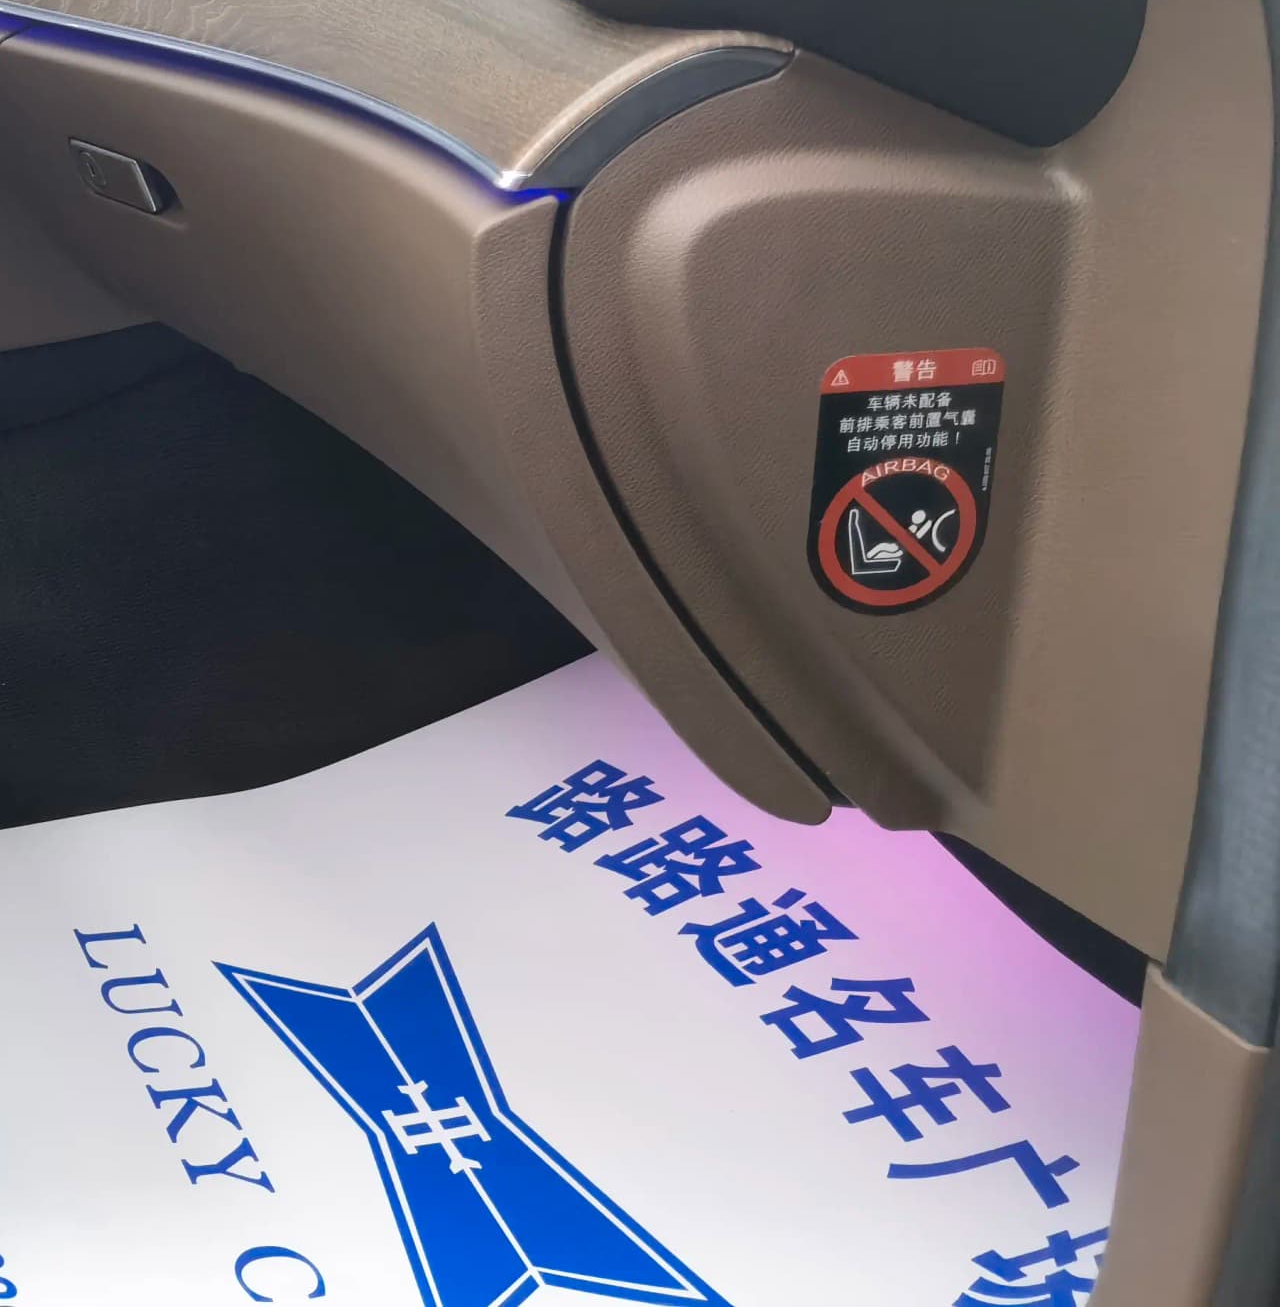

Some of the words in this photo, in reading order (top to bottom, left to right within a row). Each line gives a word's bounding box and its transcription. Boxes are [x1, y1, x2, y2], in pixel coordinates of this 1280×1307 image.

[892, 359, 937, 382] 警告
[867, 392, 952, 412] 车辆未配备
[839, 409, 977, 434] 前排乘客前置气囊
[861, 457, 951, 487] AIRBAG
[73, 923, 276, 1193] LUCKY
